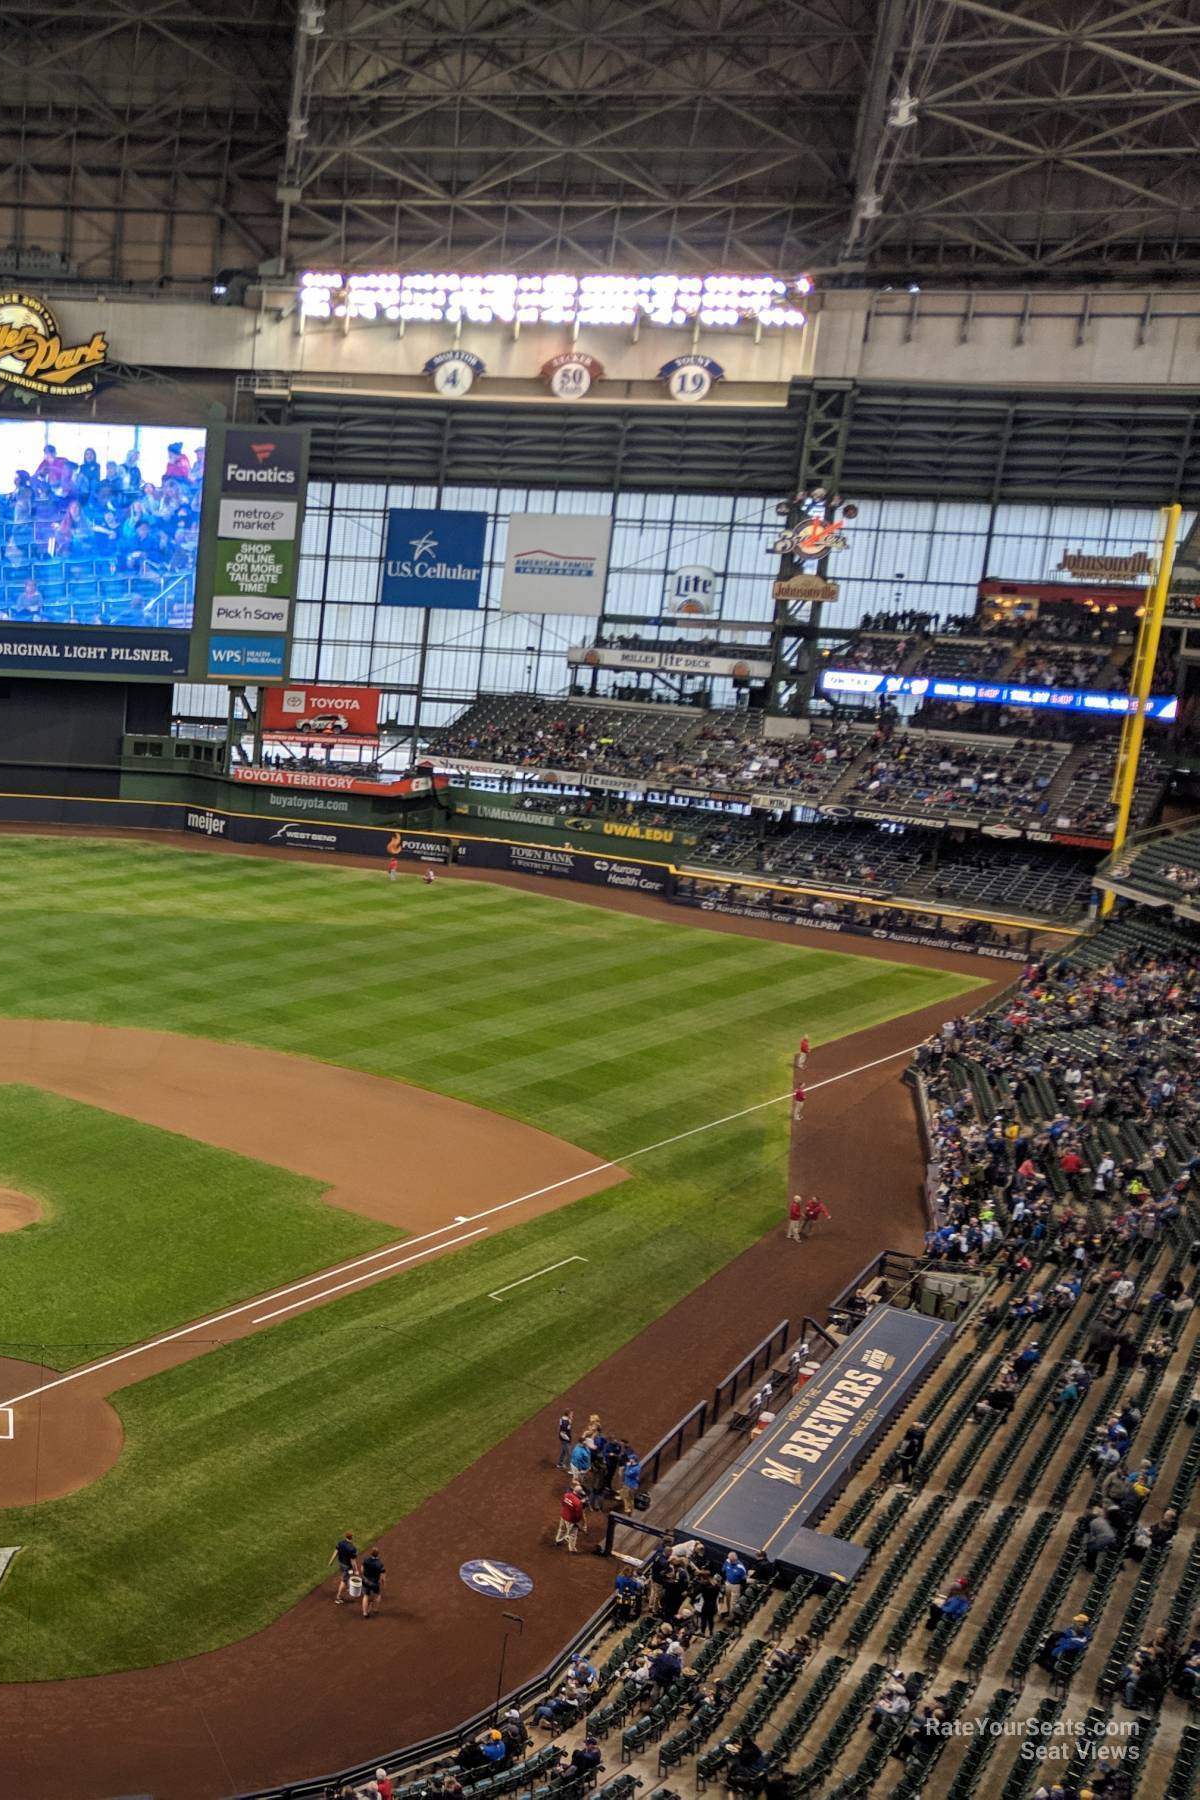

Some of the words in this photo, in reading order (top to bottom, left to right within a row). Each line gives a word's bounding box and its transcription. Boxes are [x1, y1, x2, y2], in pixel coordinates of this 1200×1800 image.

[23, 295, 44, 314] 2001
[13, 332, 109, 380] Park
[0, 370, 49, 393] MILWAUKEE
[50, 383, 93, 396] BREWERS
[445, 368, 459, 387] 4
[561, 369, 584, 385] 50
[677, 373, 704, 394] 19
[227, 464, 295, 483] Fanatics
[234, 509, 271, 519] metro
[233, 521, 275, 530] market
[240, 543, 271, 554] SHOP
[235, 553, 275, 564] ONLINE
[515, 559, 560, 568] AMERICAN
[563, 561, 594, 569] FAMILY
[226, 562, 248, 573] FOR
[250, 563, 283, 574] MORE
[229, 572, 279, 583] TAILGATE
[238, 582, 268, 592] TIME!
[676, 575, 712, 597] Lite
[775, 584, 836, 599] Johnsonville
[217, 607, 241, 618] Pick
[254, 609, 284, 620] Save
[64, 646, 107, 659] LIGHT
[110, 648, 173, 662] PILSNER.
[212, 649, 241, 662] WPS
[621, 653, 655, 663] MILLER
[684, 659, 711, 669] DECK
[310, 698, 360, 710] TOYOTA
[237, 769, 284, 785] TOYOTA
[286, 773, 354, 789] TERRITORY
[270, 794, 349, 812] buyatoyota.com
[187, 812, 226, 834] meijer
[286, 831, 310, 840] WEST
[311, 834, 337, 843] BEND
[603, 822, 674, 843] UWM.EDU
[510, 847, 542, 859] TOWN
[544, 849, 575, 866] BANK
[610, 864, 642, 876] Aurora
[607, 874, 638, 888] Health
[639, 878, 663, 891] Care
[716, 904, 743, 915] Aurora
[744, 908, 770, 920] Health
[795, 918, 841, 931] BULLPEN
[888, 932, 919, 944] Aurora
[920, 937, 950, 949] Health
[977, 947, 1029, 961] BULLPEN
[785, 1405, 806, 1421] HOME
[799, 1398, 811, 1407] OF
[805, 1387, 822, 1399] THE
[779, 1369, 884, 1464] BREWERS
